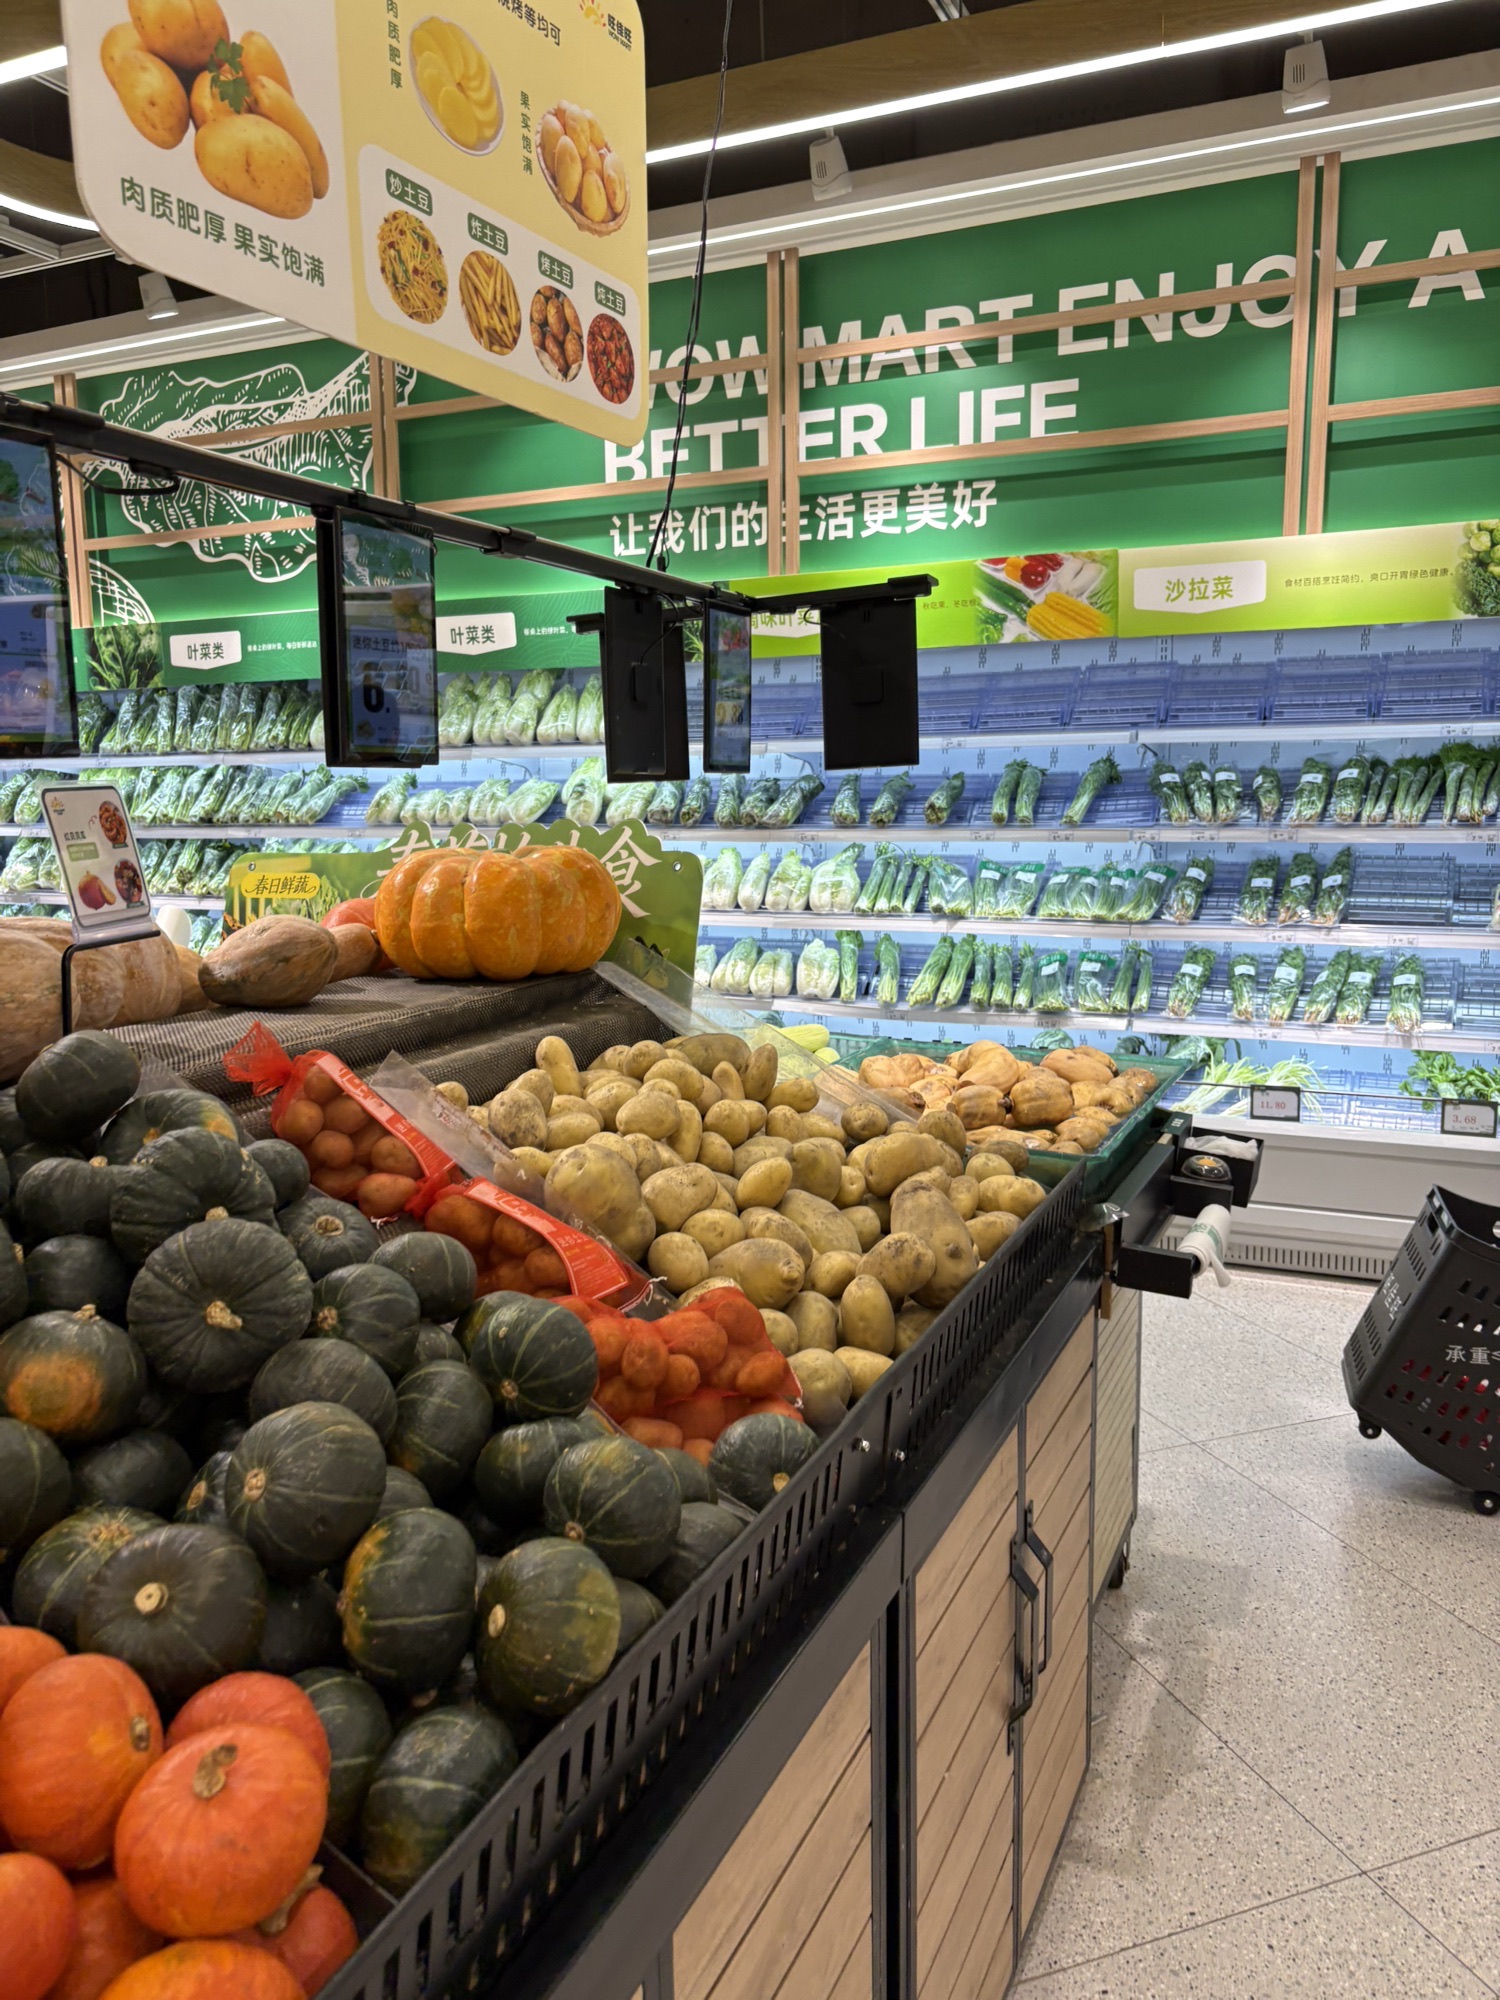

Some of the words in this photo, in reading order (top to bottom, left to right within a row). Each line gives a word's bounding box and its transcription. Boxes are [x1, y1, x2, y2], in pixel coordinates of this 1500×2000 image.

[519, 90, 534, 176] 果实饱满
[389, 173, 430, 212] 炒土豆
[120, 176, 227, 244] 肉质肥厚
[233, 222, 325, 288] 果实饱满
[470, 217, 506, 256] 炸土豆
[540, 256, 572, 287] 烤土豆
[803, 293, 1033, 389] MART
[1058, 239, 1388, 356] ENJOY
[1408, 228, 1486, 308] A
[604, 403, 888, 484] BETTER
[911, 378, 1079, 451] LIFE
[1165, 575, 1234, 602] 沙拉菜
[450, 624, 496, 646] 叶菜类
[187, 641, 224, 661] 叶菜类
[248, 874, 314, 895] 春日鲜蔬
[1260, 1101, 1287, 1110] 11.80
[1452, 1114, 1477, 1125] 3.68
